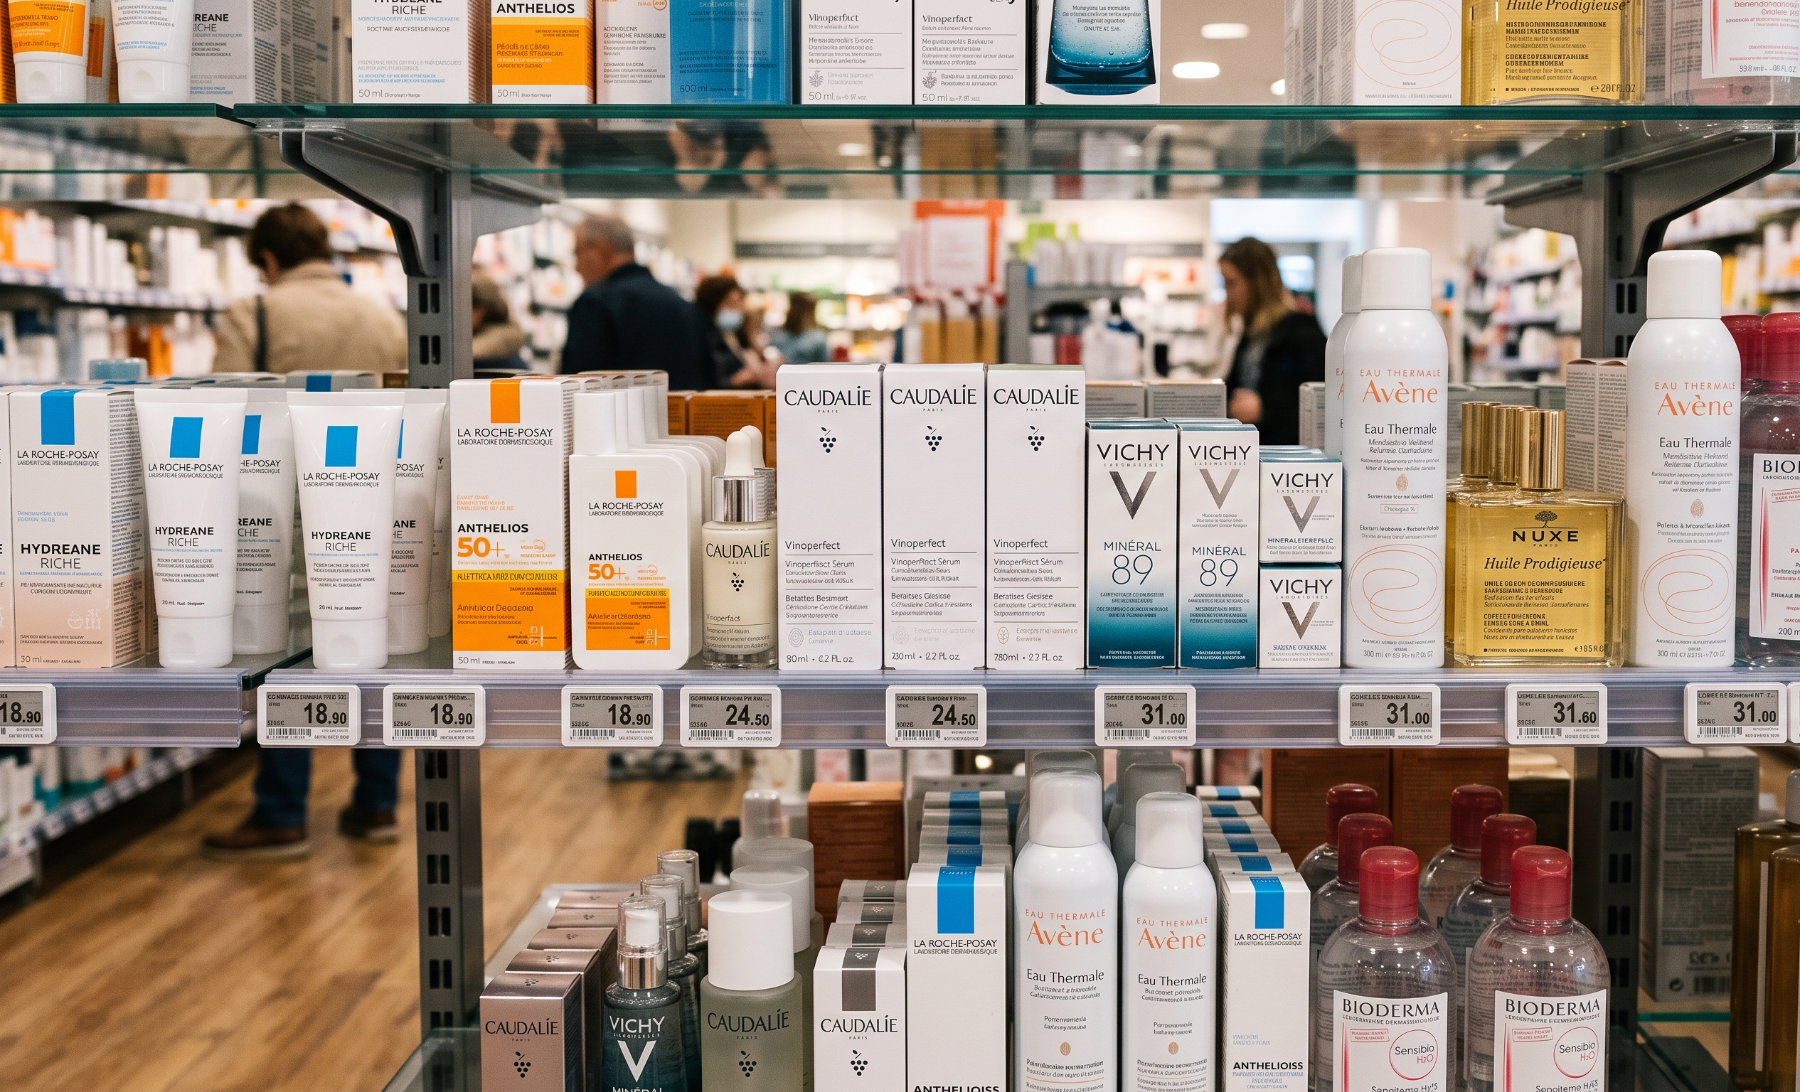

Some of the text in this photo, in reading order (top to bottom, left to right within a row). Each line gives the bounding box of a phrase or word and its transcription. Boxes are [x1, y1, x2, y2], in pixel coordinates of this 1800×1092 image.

[392, 6, 426, 14] RICHE
[497, 4, 574, 13] ANTHELIOS
[359, 89, 383, 97] 50 ml
[498, 89, 519, 97] 50 ml
[809, 92, 821, 100] 50
[937, 92, 948, 102] ml
[1360, 369, 1380, 377] EAU
[1655, 382, 1735, 390] EAU THERMALE
[1362, 381, 1437, 403] Avène
[1657, 394, 1732, 416] Avène
[458, 429, 553, 437] LA ROCHE-POSAY
[1365, 424, 1436, 434] Eau Thermale
[1660, 437, 1731, 448] Eau Thermale
[32, 451, 99, 459] ROCHE-POSAY
[1097, 444, 1169, 460] VICHY
[1189, 446, 1251, 460] VICHY
[1764, 460, 1800, 473] BIO
[1271, 473, 1333, 487] VICHY
[156, 527, 213, 535] HYDREANE
[458, 524, 528, 532] ANTHELIOS
[168, 538, 198, 546] RICHE
[1513, 531, 1578, 542] NUXE
[21, 544, 100, 554] HYDREANE
[326, 543, 356, 551] RICHE
[457, 537, 504, 559] 50+
[785, 541, 840, 552] Vinoperfect
[891, 539, 945, 550] Vinoperfect
[994, 539, 1048, 548] Vinoperfect
[1104, 540, 1161, 551] MINÉRAL
[1193, 545, 1246, 555] MINÉRAL
[41, 558, 80, 569] RICHE
[1484, 558, 1520, 569] Huile
[588, 563, 625, 581] 50+
[1112, 555, 1153, 585] 89
[1200, 559, 1238, 586] 89
[1270, 580, 1332, 594] VICHY
[32, 655, 42, 663] ml
[471, 656, 480, 665] ml
[0, 702, 41, 723] 18.90
[304, 703, 346, 724] 18.90
[431, 703, 472, 725] 18.90
[609, 704, 650, 725] 18.90
[726, 704, 769, 726] 24.50
[932, 704, 975, 725] 24.50
[1142, 704, 1185, 725] 31.00
[1387, 703, 1429, 724] 31.00
[1554, 702, 1596, 723] 31.60
[1734, 701, 1776, 722] 31.00
[1026, 909, 1105, 920] EAU THERMALE
[1137, 917, 1207, 927] EAU THERMALE
[1027, 921, 1103, 946] Avène
[1139, 928, 1206, 949] Avène
[1247, 933, 1302, 942] ROCHE-POSAY
[1028, 969, 1104, 983] Eau Thermale
[1139, 974, 1206, 986] Eau Thermale
[1342, 998, 1440, 1017] BIODERMA
[1505, 998, 1600, 1016] BIODERMA
[609, 1015, 665, 1033] VICHY
[1394, 1043, 1435, 1056] Sensibio
[1559, 1042, 1596, 1054] Sensibio
